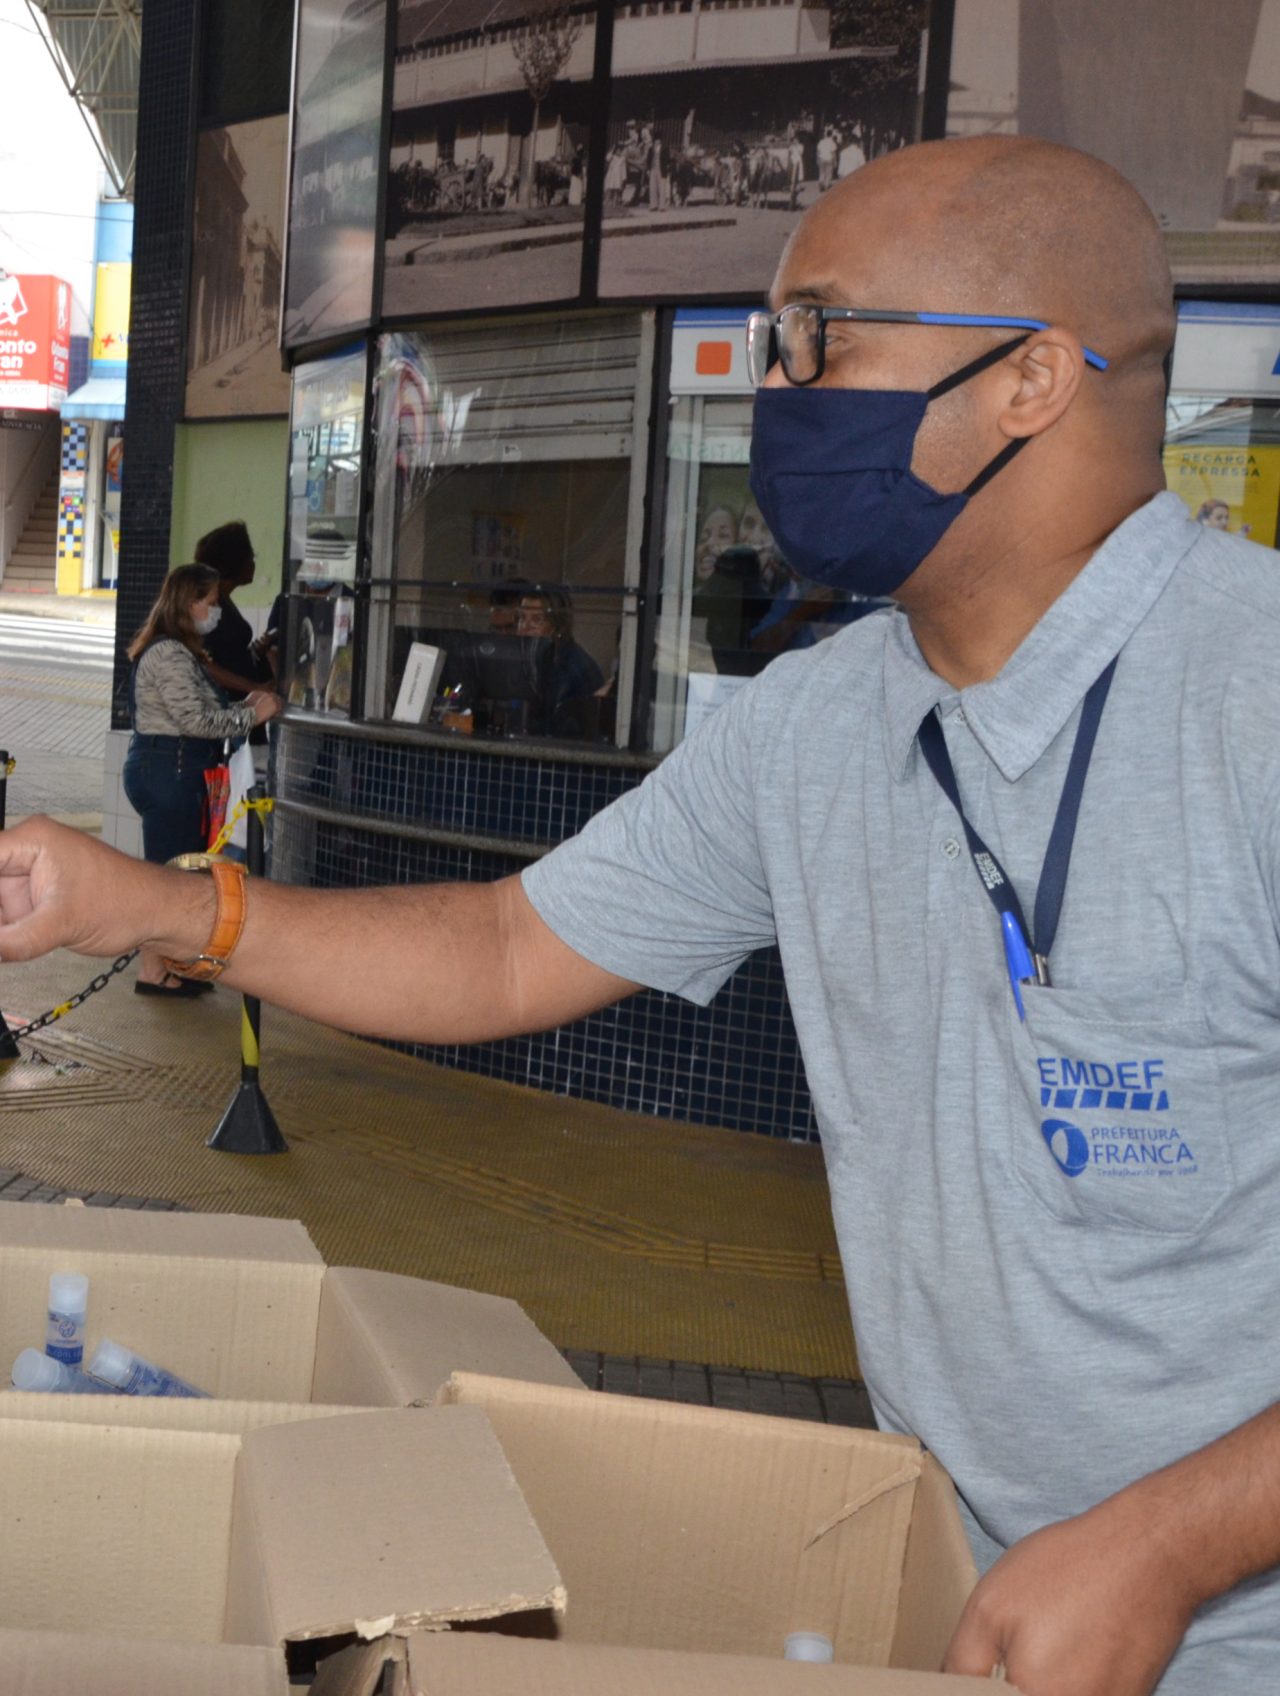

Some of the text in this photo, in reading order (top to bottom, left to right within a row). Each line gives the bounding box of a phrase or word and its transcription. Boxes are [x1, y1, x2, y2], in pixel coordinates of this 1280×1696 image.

[1182, 453, 1256, 465] RECARGA
[1180, 465, 1261, 477] EXPRESSA
[1037, 1057, 1164, 1090] EMDEF
[1091, 1127, 1181, 1141] PREFEITURA
[1093, 1142, 1194, 1165] FRANCA
